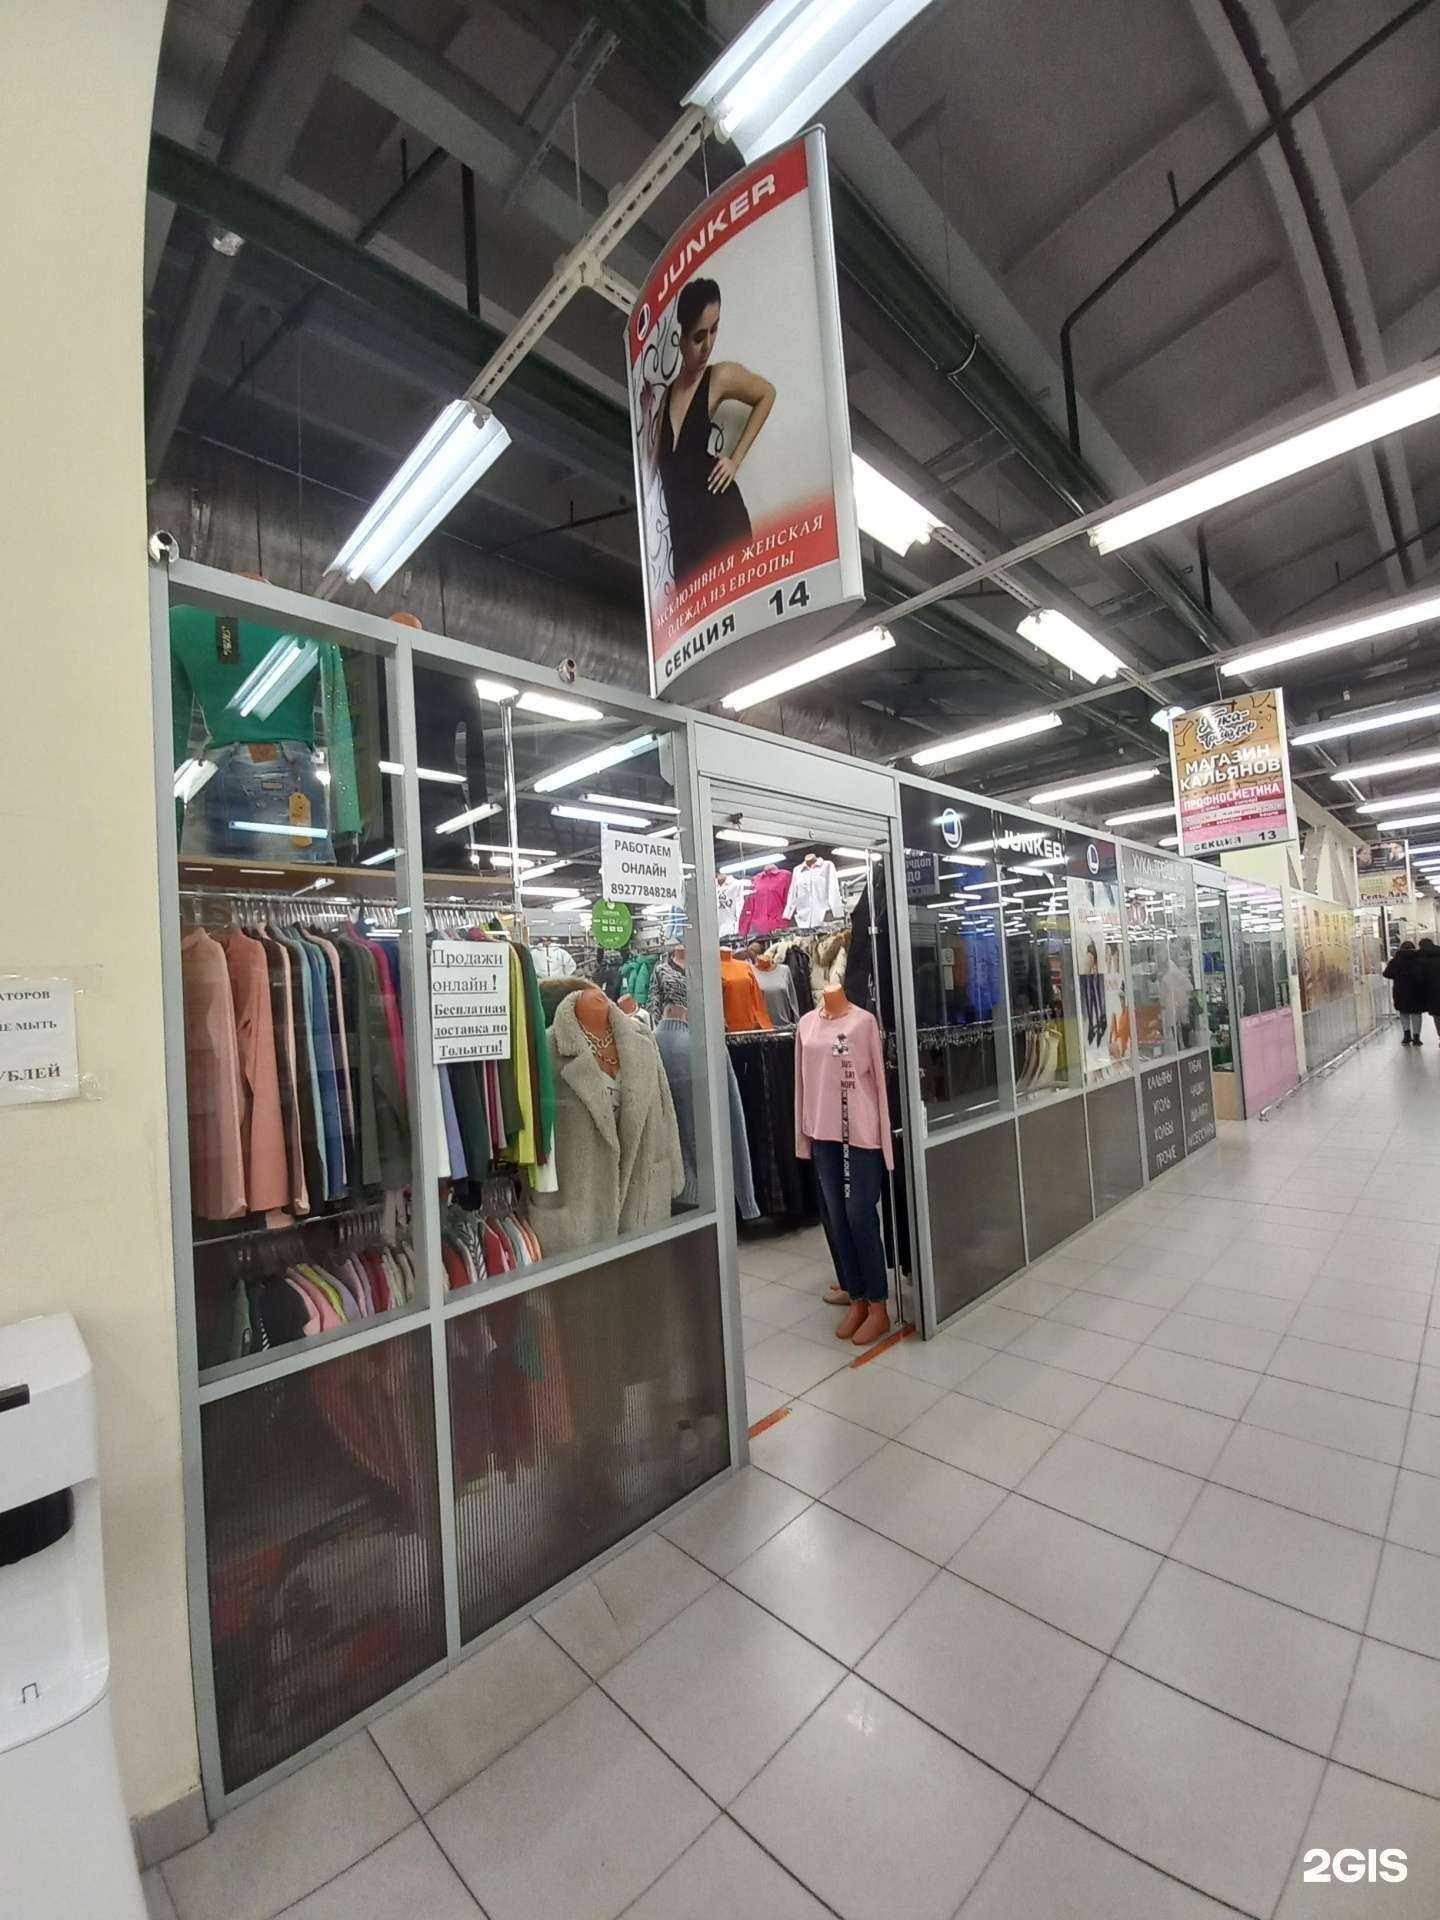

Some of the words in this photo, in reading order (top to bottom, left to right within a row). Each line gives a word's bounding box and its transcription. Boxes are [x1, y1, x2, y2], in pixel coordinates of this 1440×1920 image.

[657, 173, 776, 302] JUNKER
[656, 554, 735, 629] ЭКСКЛЮЗИВНАЯ
[740, 514, 824, 564] ЖЕНСКАЯ
[668, 595, 708, 638] ОДЕЖДА
[710, 583, 726, 604] ИЗ
[729, 550, 795, 593] ЕВРОПЫ
[664, 613, 736, 678] СЕКЦИЯ
[768, 580, 811, 616] 14
[1185, 743, 1271, 776] МАГАЗИН
[1180, 758, 1281, 792] КАЛЬЯНОВ
[1184, 781, 1282, 811] ПРОФКОСМЕТИКА
[1258, 830, 1277, 841] 13
[614, 839, 672, 857] РАБОТАЕМ
[621, 862, 667, 877] ОНЛАЙН
[611, 883, 677, 899] 89277848284
[432, 949, 503, 969] Продажи
[434, 1003, 507, 1018] Бесплатная
[15, 1020, 58, 1032] МЫТЬ
[434, 1025, 489, 1038] доставка
[492, 1024, 508, 1033] по
[440, 1039, 503, 1058] Тольятти!
